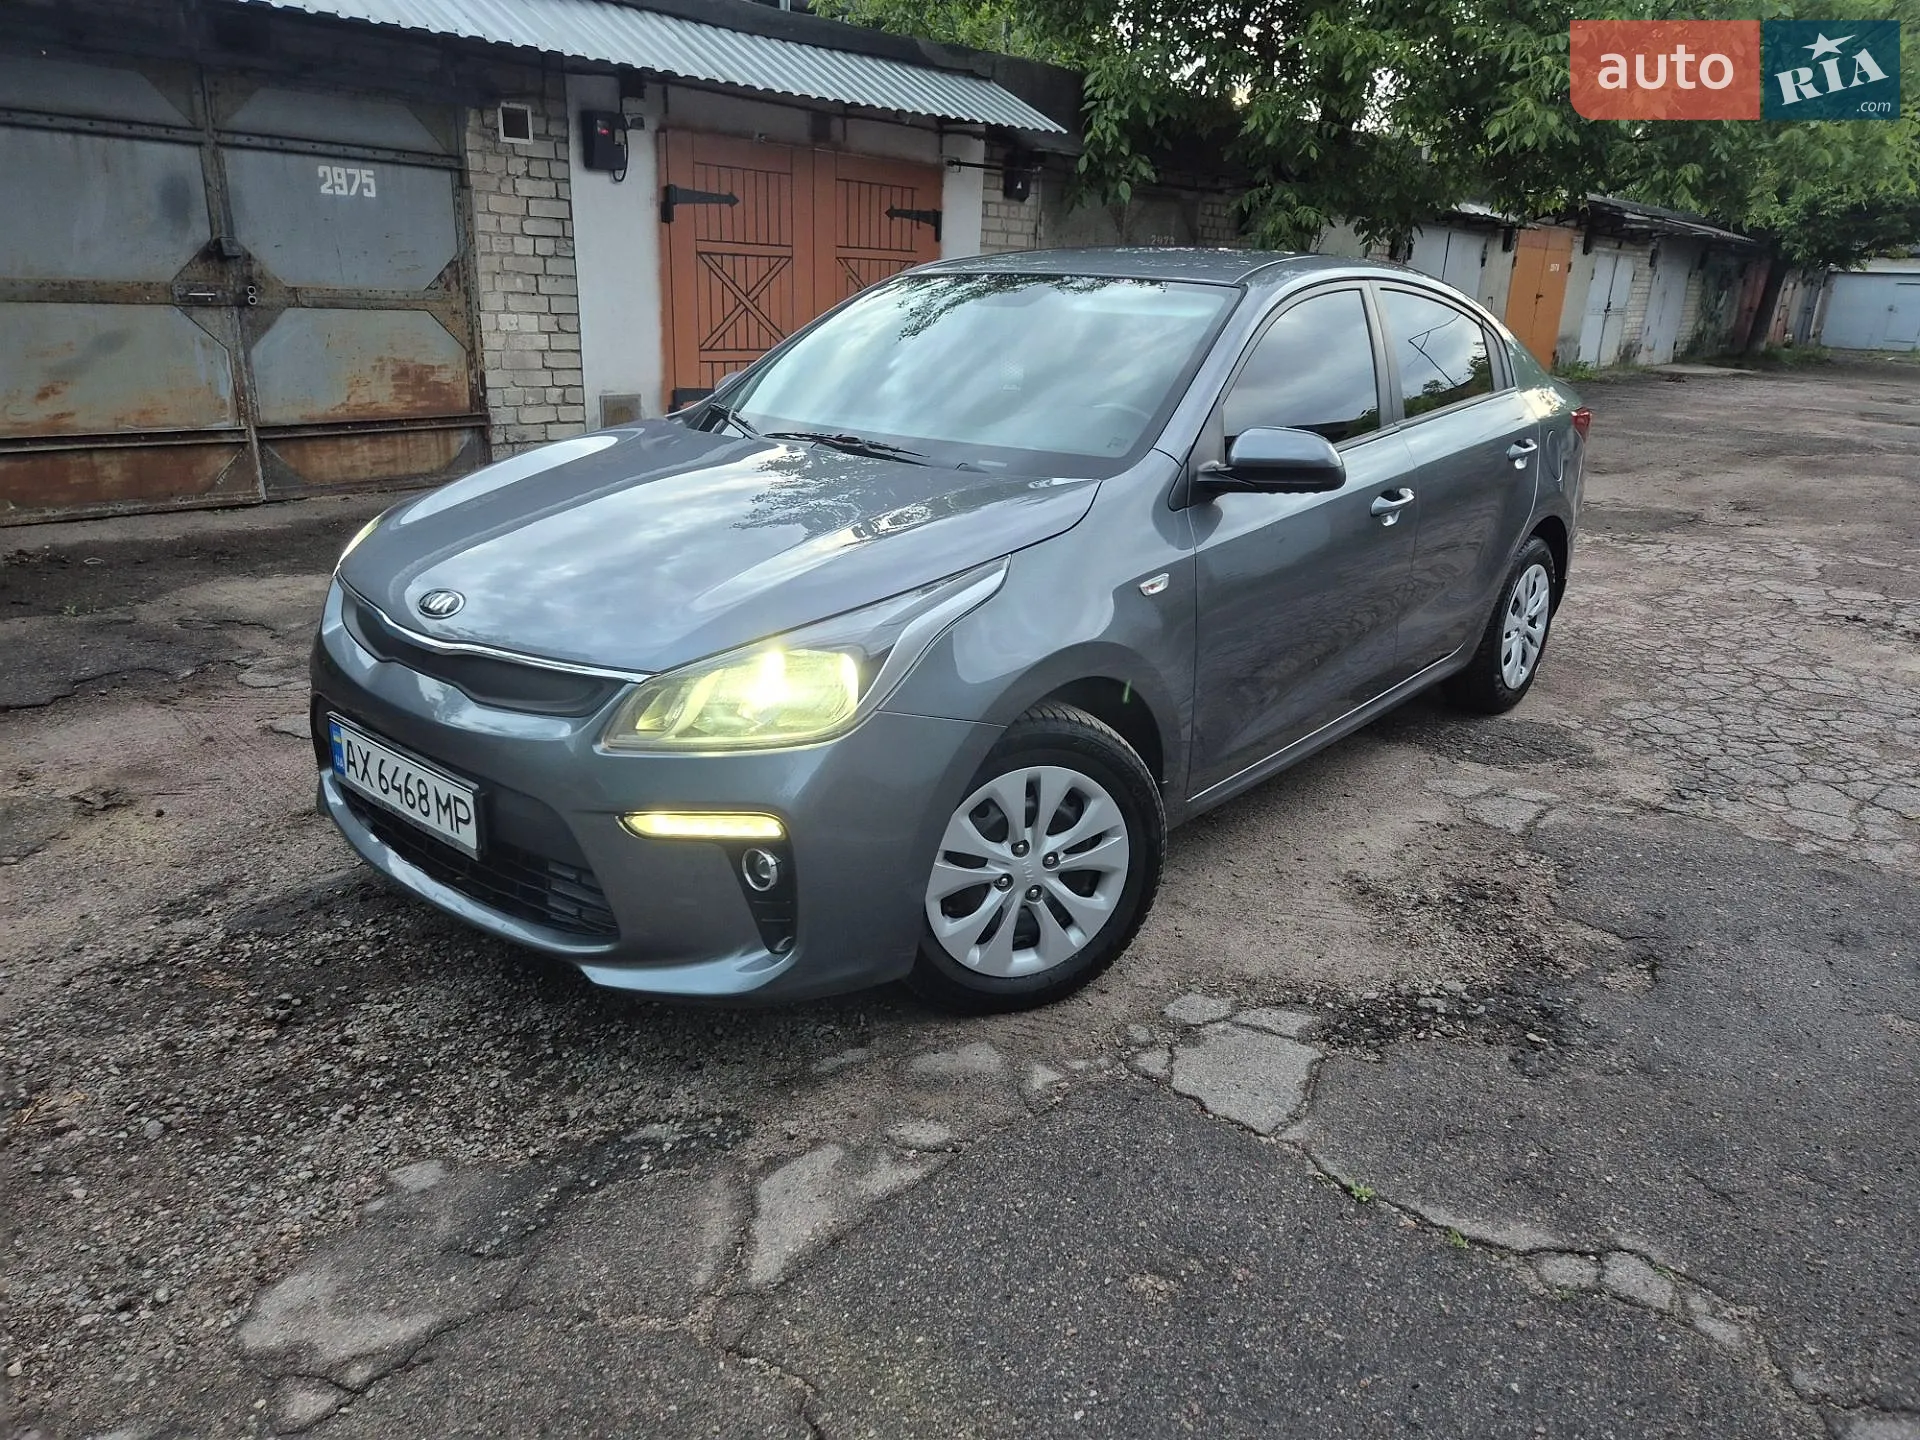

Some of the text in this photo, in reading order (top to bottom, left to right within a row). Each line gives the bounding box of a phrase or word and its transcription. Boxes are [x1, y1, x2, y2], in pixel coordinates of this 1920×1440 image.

[318, 165, 376, 197] 2975
[335, 754, 345, 769] UA
[346, 739, 472, 834] AX 6468 MP
